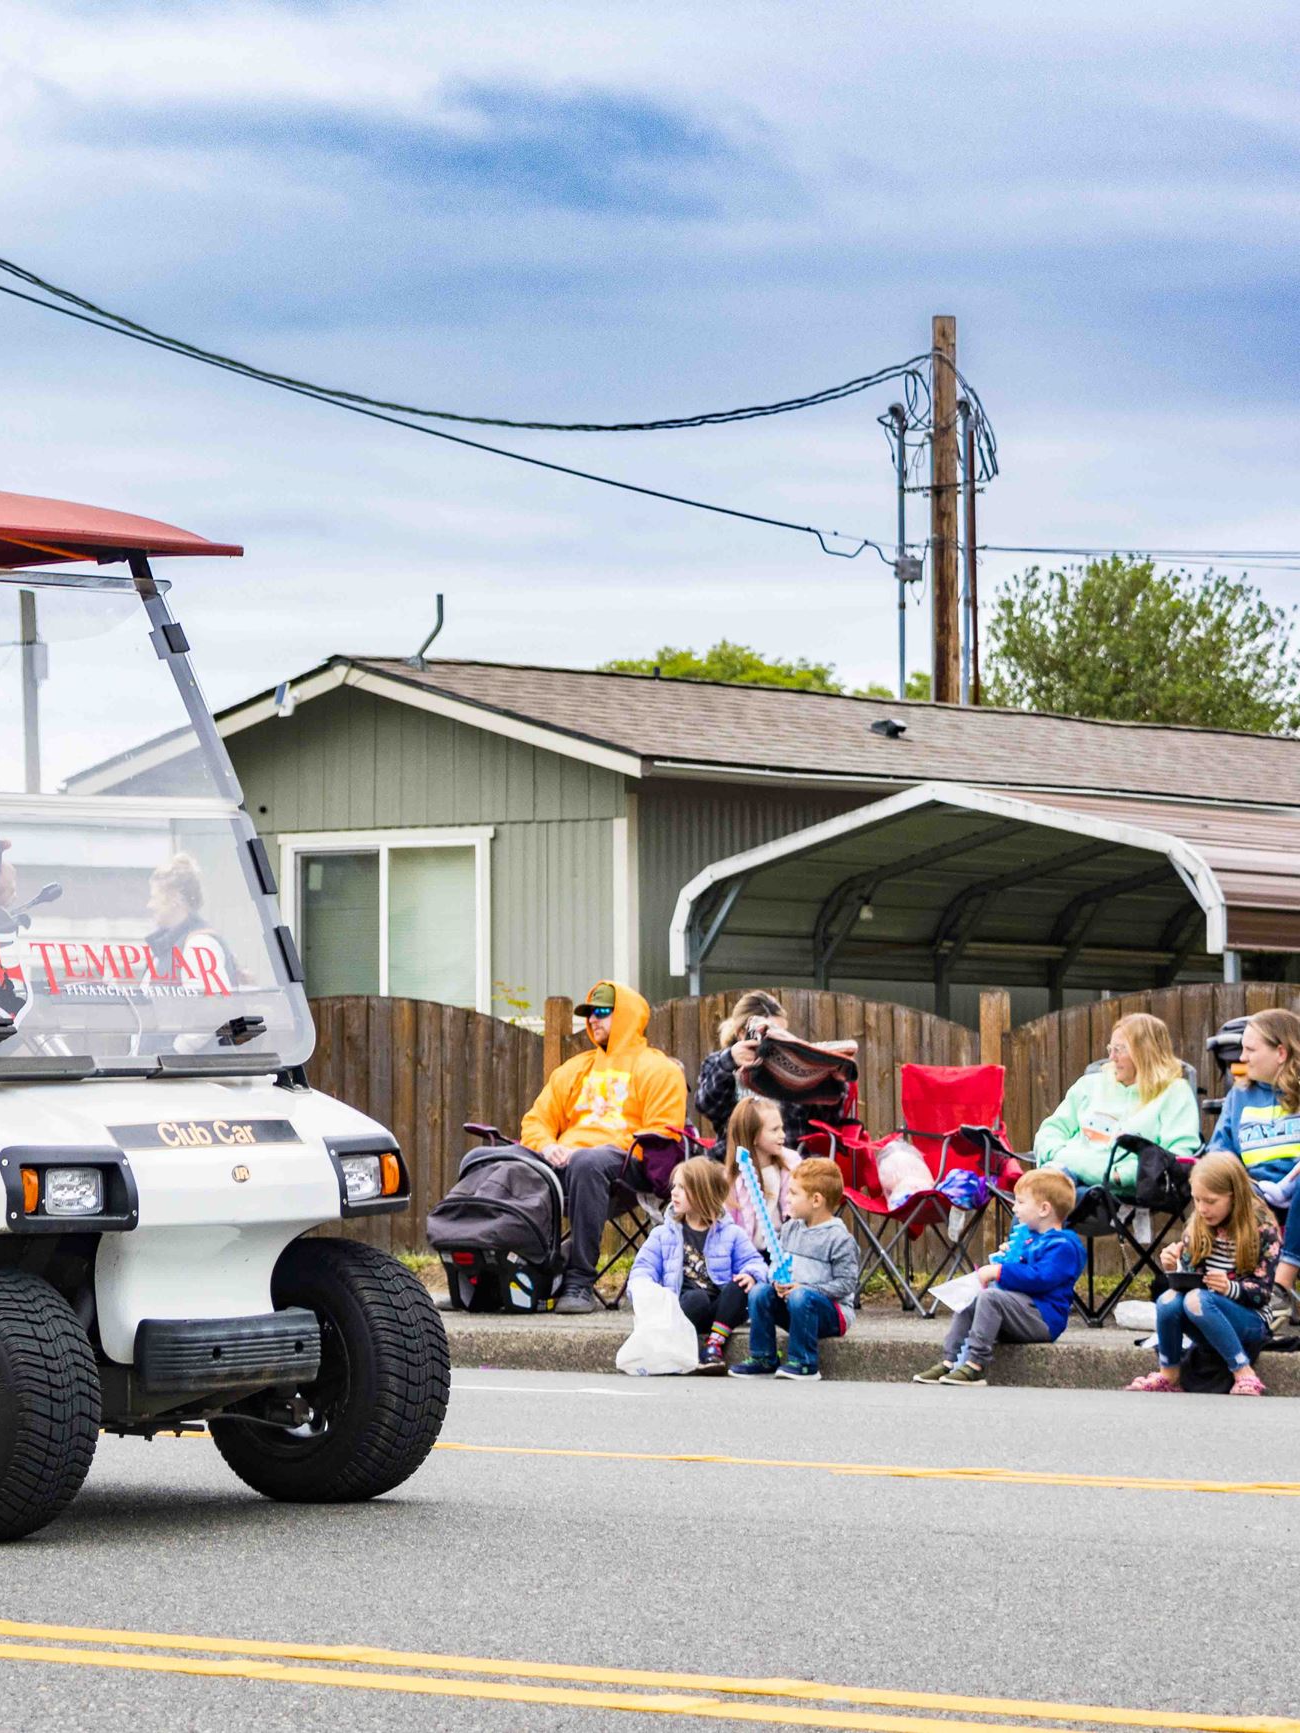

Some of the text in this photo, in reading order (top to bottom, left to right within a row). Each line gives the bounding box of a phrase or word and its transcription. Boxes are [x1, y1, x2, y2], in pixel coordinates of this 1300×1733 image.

[29, 943, 232, 997] TEMPLAR
[64, 983, 200, 998] FINANCIAL SERVICES
[157, 1120, 256, 1147] Club Car
